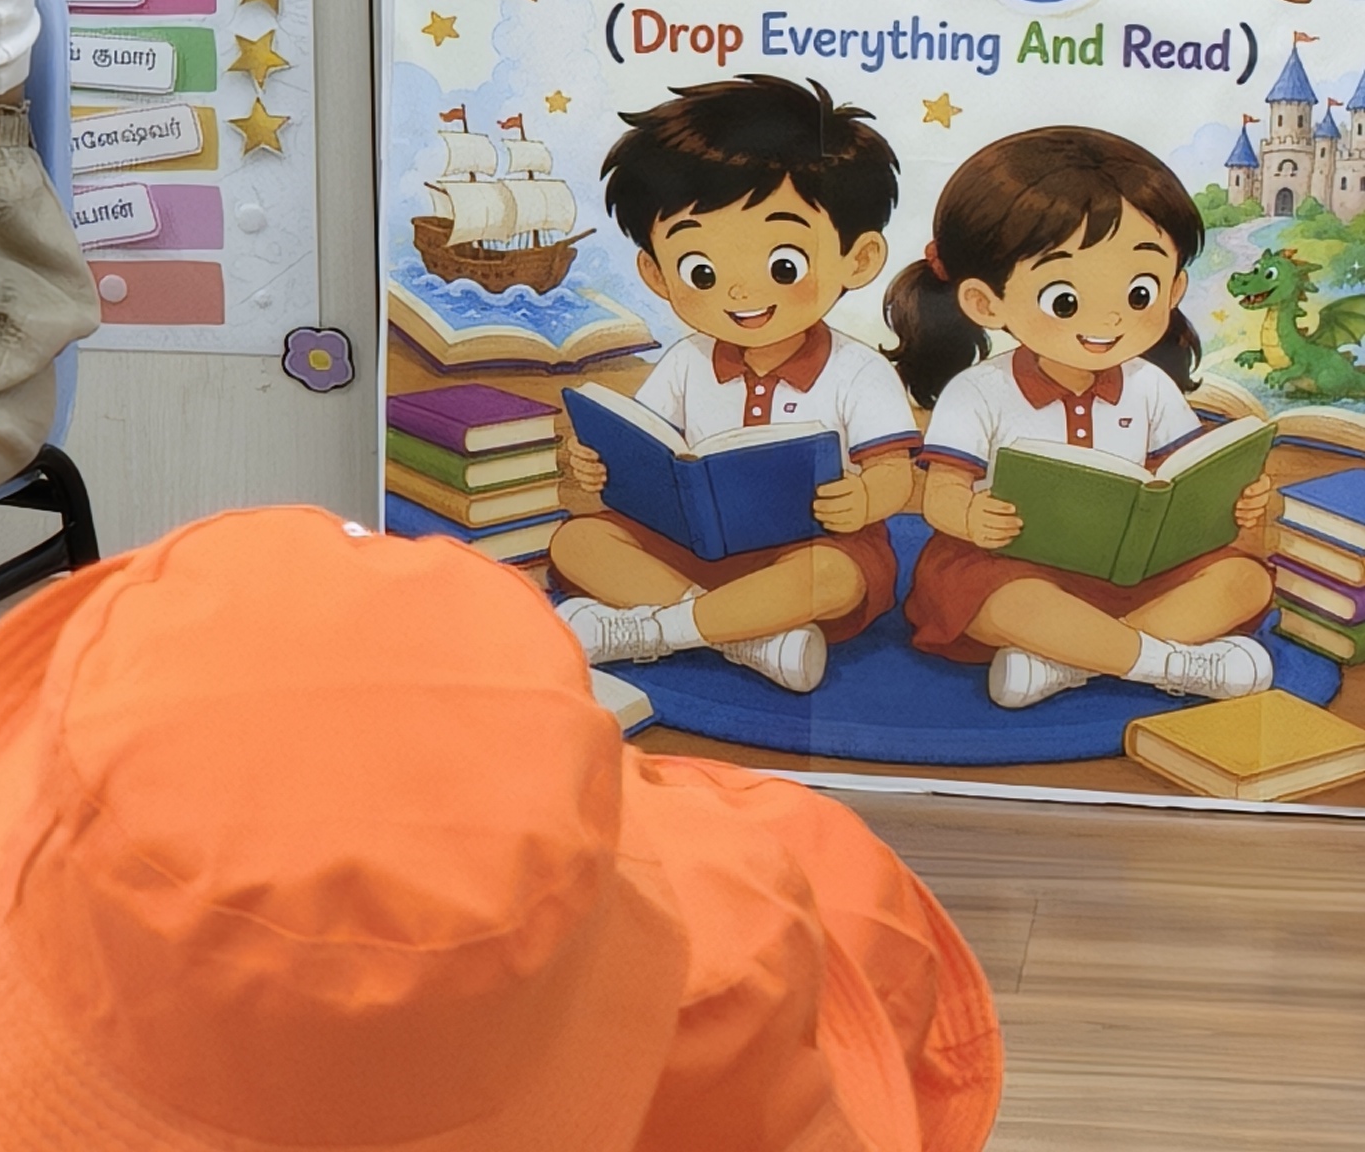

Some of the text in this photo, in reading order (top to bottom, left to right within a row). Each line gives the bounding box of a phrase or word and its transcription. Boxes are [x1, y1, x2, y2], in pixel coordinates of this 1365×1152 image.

[604, 3, 1259, 84] (Drop Everything And Read)
